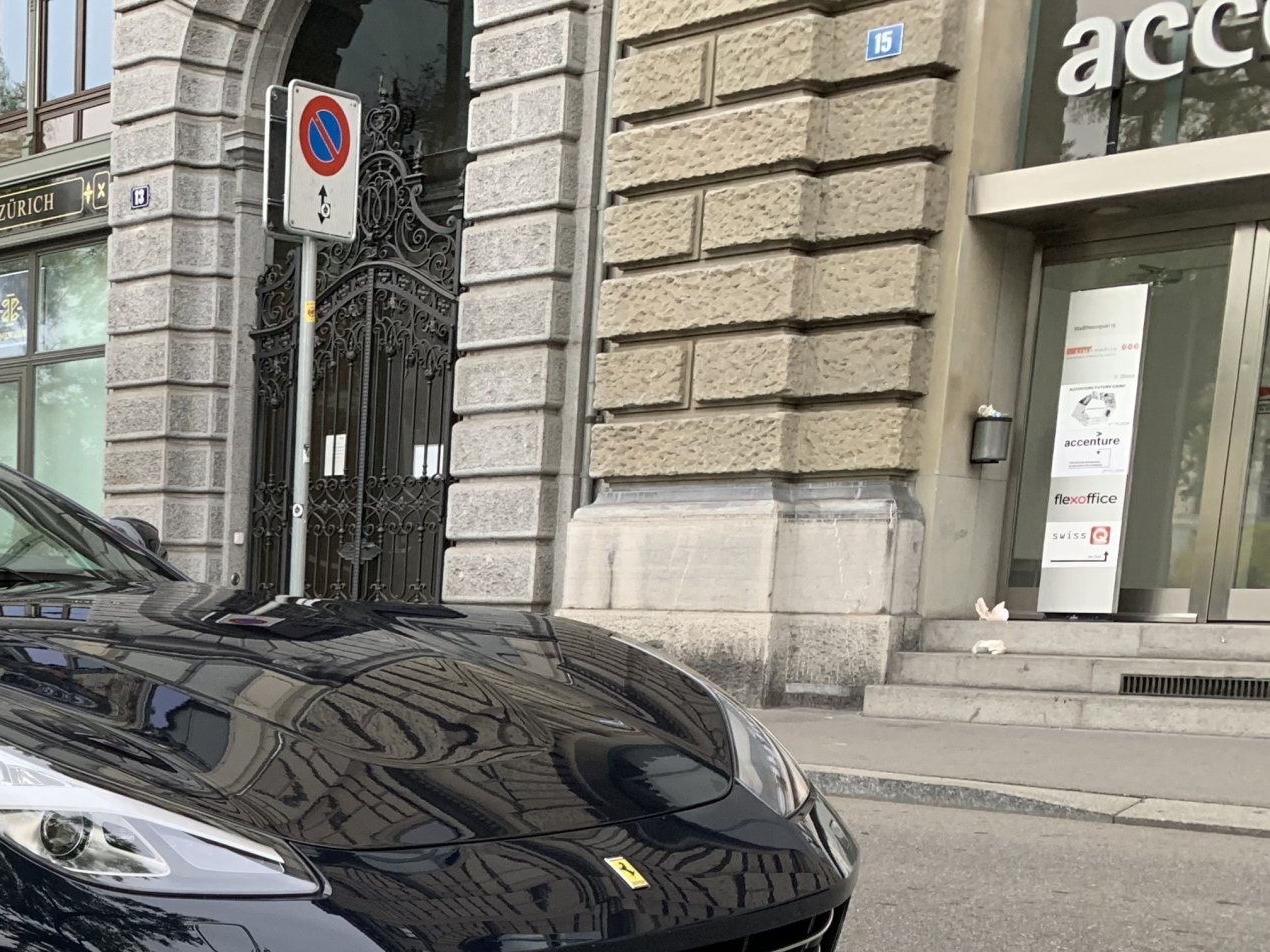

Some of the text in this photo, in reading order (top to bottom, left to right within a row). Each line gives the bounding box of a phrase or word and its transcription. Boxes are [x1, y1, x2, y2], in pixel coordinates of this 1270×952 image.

[875, 30, 893, 54] 15
[1057, 0, 1270, 96] acc
[134, 189, 145, 205] 13
[1064, 437, 1120, 447] accenture
[1054, 492, 1118, 505] flexoffice
